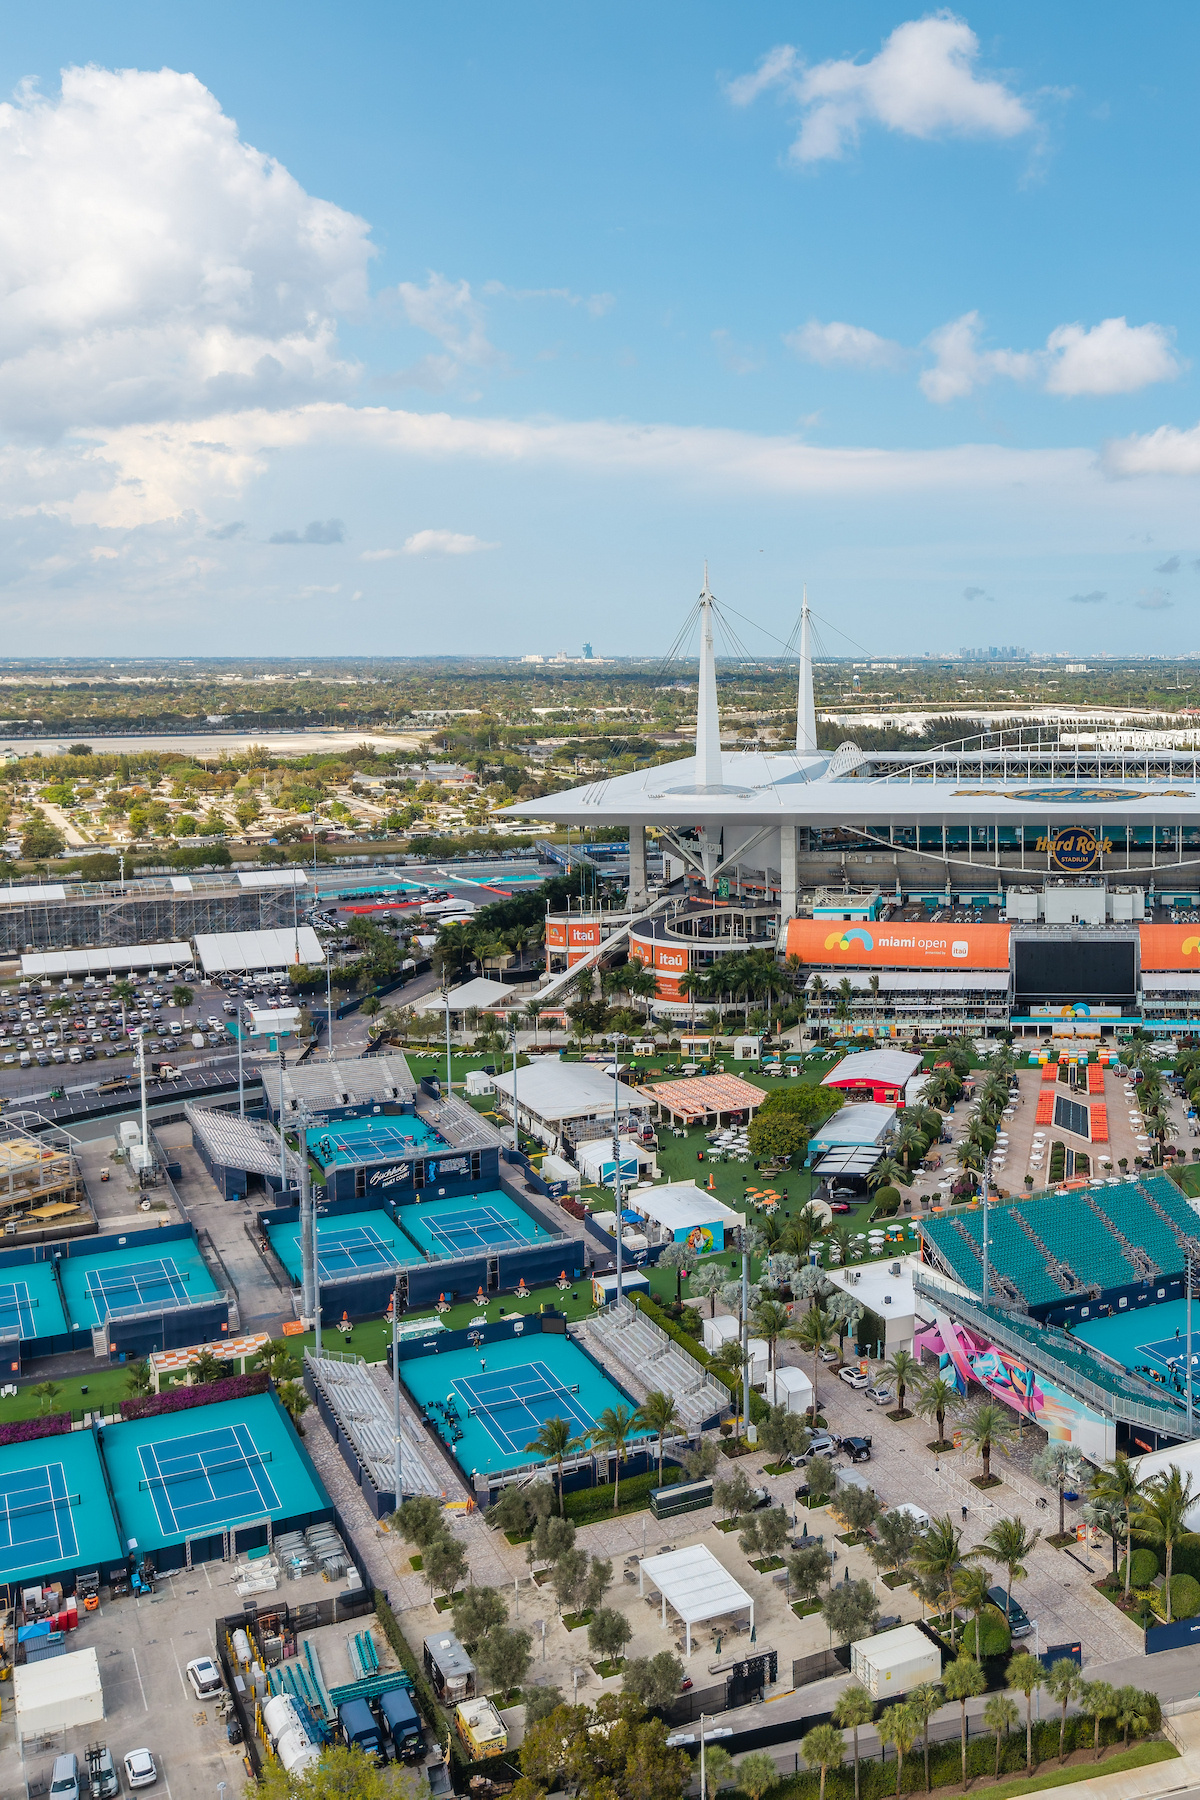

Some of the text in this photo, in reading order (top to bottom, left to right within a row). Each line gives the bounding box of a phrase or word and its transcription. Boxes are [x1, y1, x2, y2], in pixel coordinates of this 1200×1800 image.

[949, 790, 1196, 799] Hard Rock
[1035, 836, 1113, 855] Hard Rock
[573, 929, 594, 940] itaú
[878, 936, 948, 951] miami open
[660, 952, 682, 966] itaú
